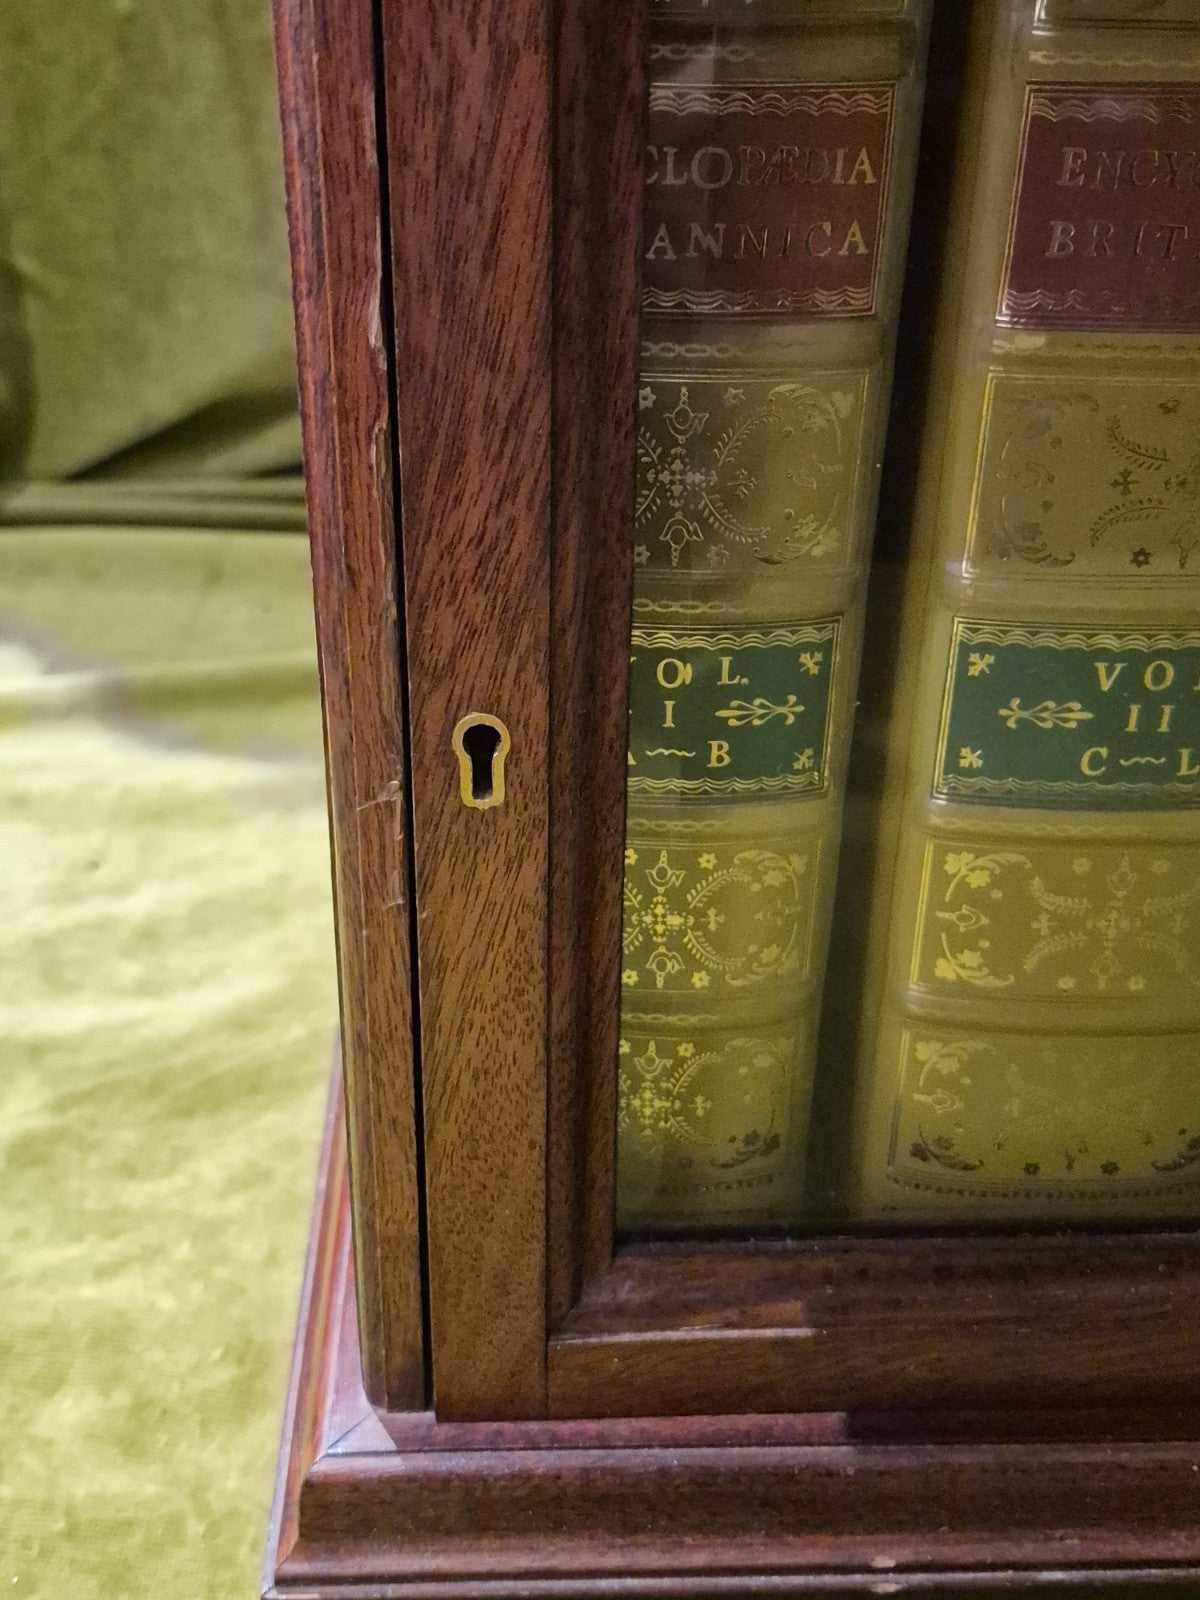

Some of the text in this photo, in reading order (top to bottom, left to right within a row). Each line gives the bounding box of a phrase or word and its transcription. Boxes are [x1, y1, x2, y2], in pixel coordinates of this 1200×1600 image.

[1056, 147, 1200, 190] ENCY
[1044, 219, 1200, 261] BRIT
[630, 656, 749, 689] OL.
